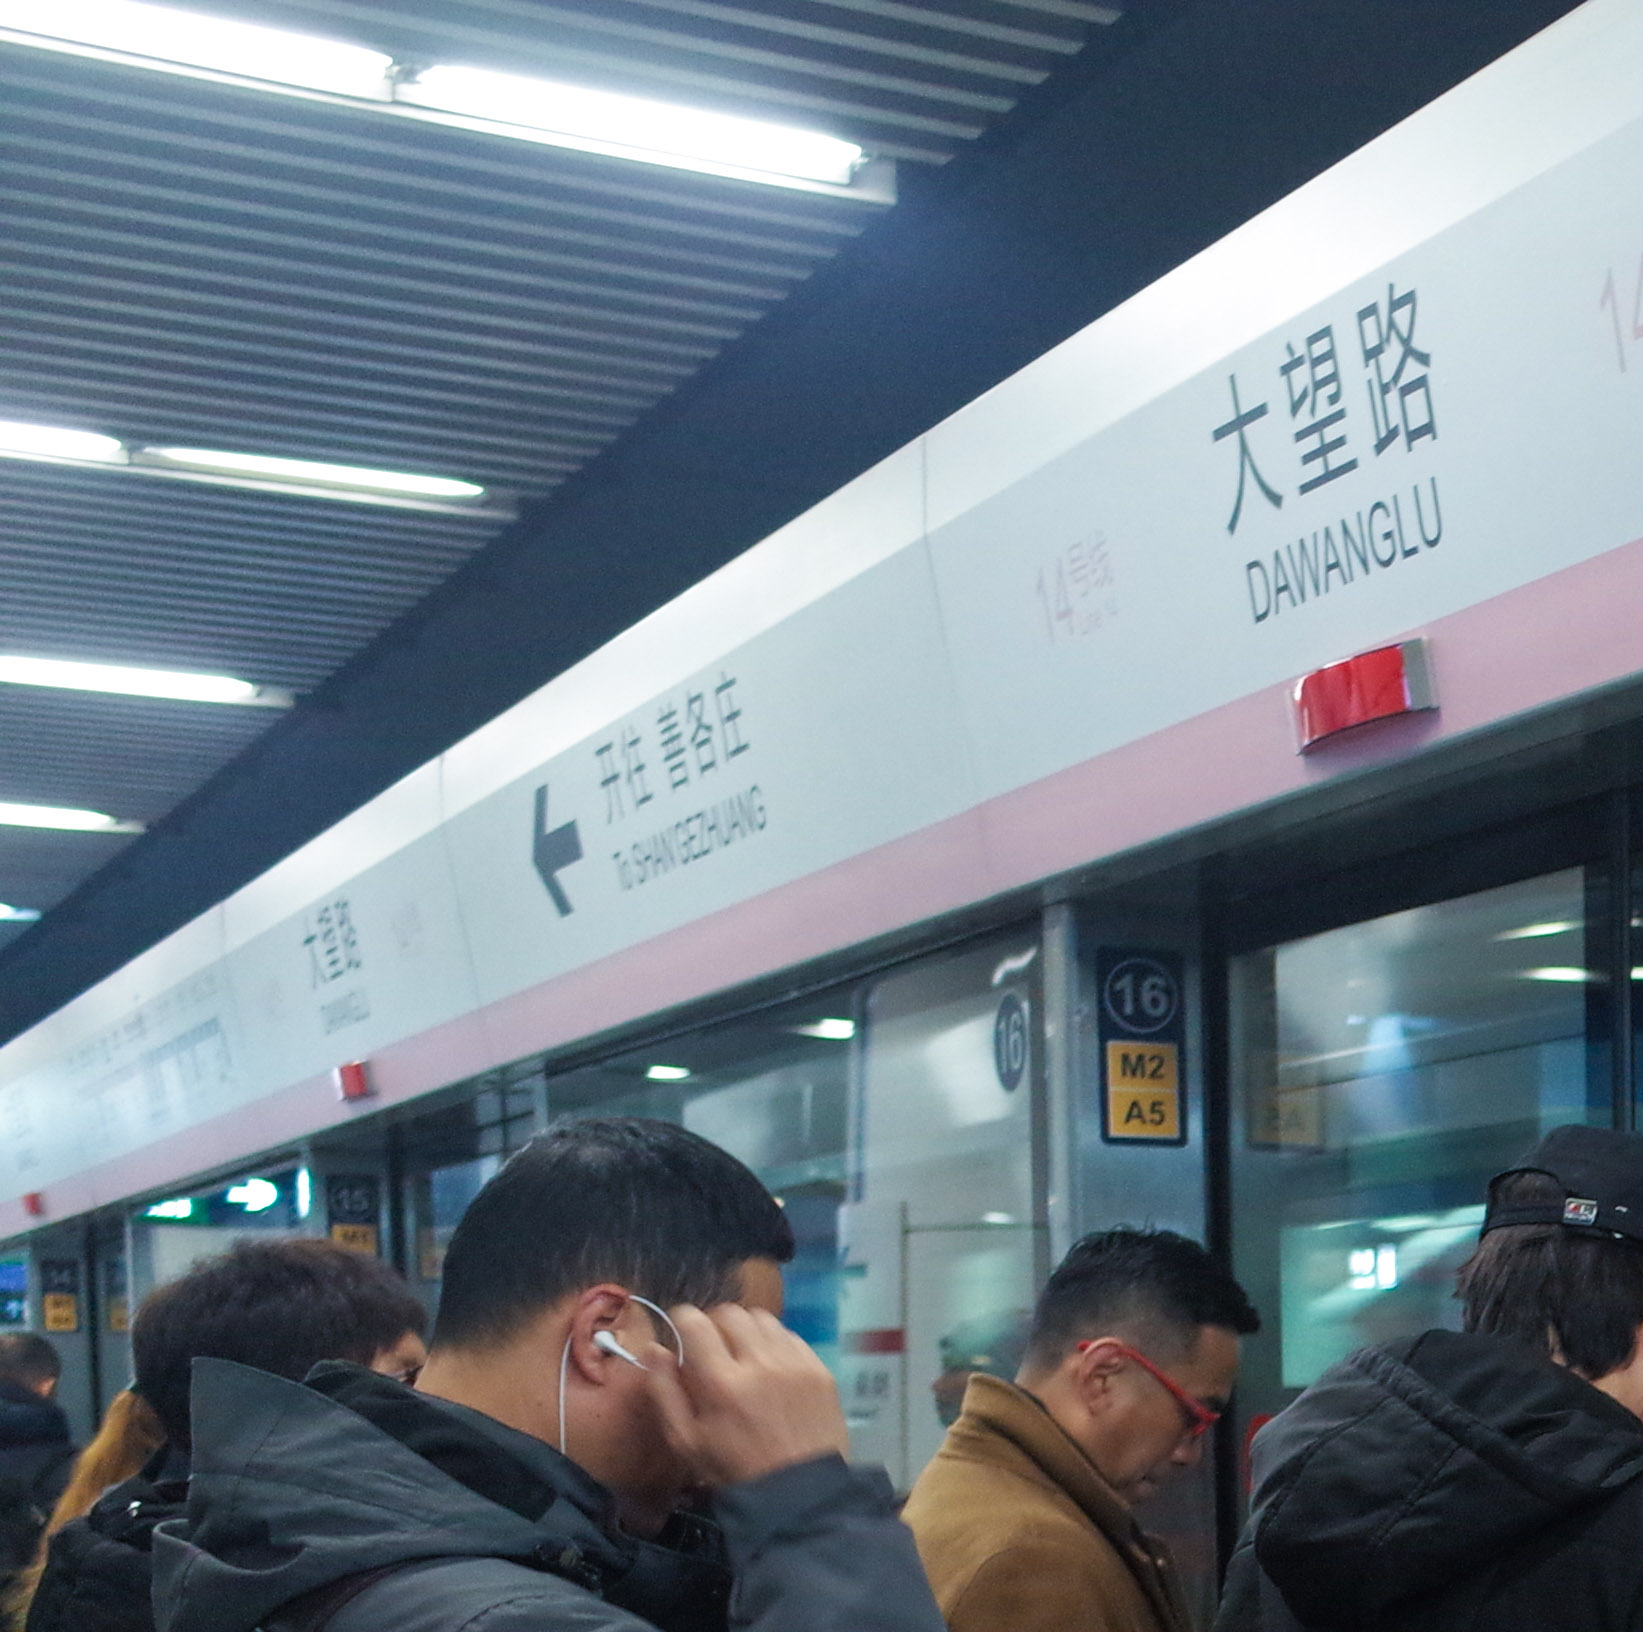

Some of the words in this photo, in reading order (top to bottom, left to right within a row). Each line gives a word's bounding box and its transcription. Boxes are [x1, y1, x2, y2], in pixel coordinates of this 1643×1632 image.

[1212, 282, 1438, 537] 大望路
[1245, 475, 1443, 624] DAWANGLU
[595, 724, 654, 825] 开往
[656, 670, 751, 794] 善各庄
[1112, 972, 1170, 1018] 16
[998, 1011, 1025, 1078] 16
[1120, 1053, 1167, 1083] M2
[1123, 1099, 1167, 1128] A5
